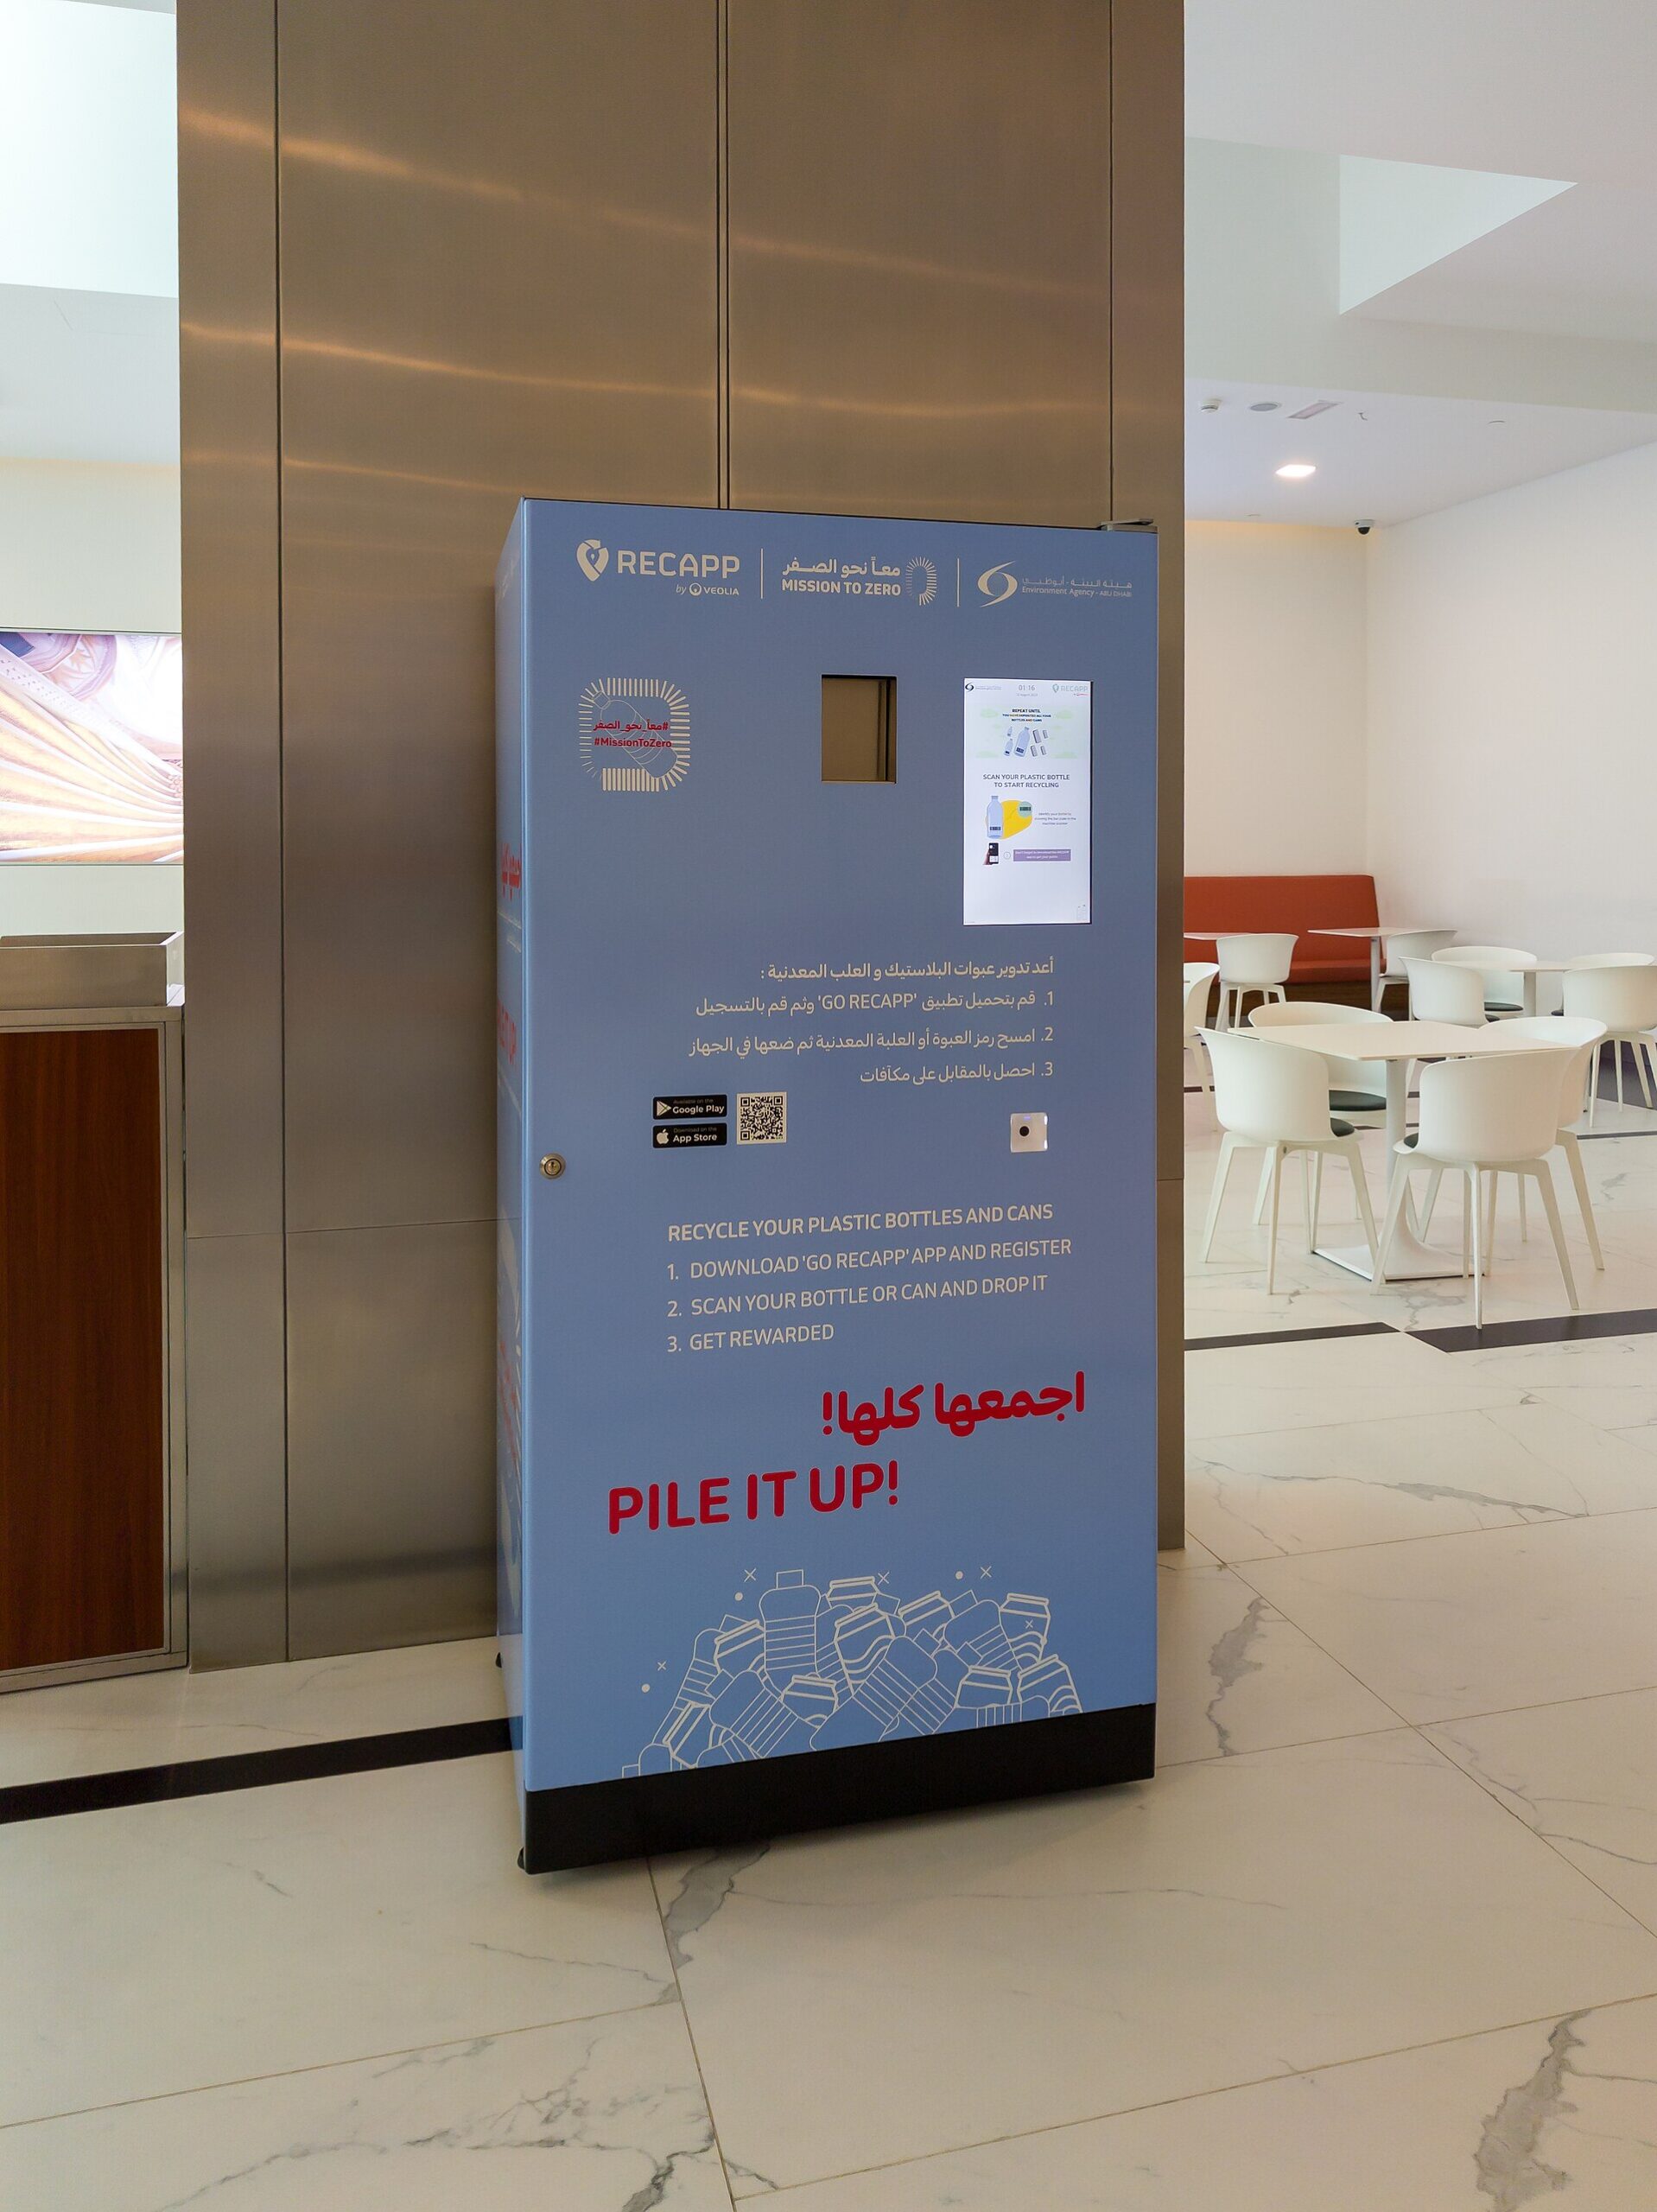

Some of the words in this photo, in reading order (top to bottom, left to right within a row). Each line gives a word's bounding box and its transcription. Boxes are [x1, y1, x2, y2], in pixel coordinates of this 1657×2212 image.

[617, 550, 740, 579] RECAPP
[782, 556, 837, 575] الصفر
[841, 562, 867, 578] نحو
[676, 584, 686, 595] by
[703, 587, 740, 595] VEOLIA
[782, 579, 841, 594] MISSION
[843, 582, 862, 594] TO
[865, 582, 901, 596] ZERO
[1022, 586, 1067, 594] Environment
[1070, 588, 1095, 598] Agency
[594, 737, 672, 748] #MissionToZero
[768, 963, 827, 982] المعدنية
[829, 963, 871, 981] العلب
[885, 962, 951, 979] البلاستيك
[954, 961, 995, 979] عبوات
[996, 962, 1030, 979] تدوير
[1032, 956, 1054, 974] أعد
[696, 997, 765, 1015] بالتسجيل
[767, 996, 788, 1017] قم
[790, 996, 815, 1016] وثم
[922, 993, 963, 1011] تطبيق
[966, 992, 1015, 1009] بتحميل
[1017, 990, 1036, 1010] قم
[1044, 991, 1054, 1006] 1.
[816, 1032, 873, 1052] المعدنية
[876, 1033, 915, 1050] العلبة
[917, 1027, 930, 1050] أو
[933, 1030, 972, 1049] العبوة
[973, 1033, 994, 1048] رمز
[997, 1028, 1035, 1048] امسح
[1041, 1027, 1053, 1041] 2.
[689, 1037, 733, 1057] الجهاز
[737, 1036, 751, 1059] في
[754, 1036, 794, 1054] ضعها
[797, 1035, 813, 1055] ثم
[912, 1066, 936, 1085] على
[938, 1065, 992, 1083] بالمقابل
[994, 1062, 1035, 1080] احصل
[1041, 1062, 1053, 1077] 3.
[672, 1105, 704, 1115] Google
[706, 1104, 725, 1114] Play
[672, 1135, 692, 1144] App
[694, 1133, 718, 1141] Store
[668, 1221, 749, 1242] RECYCLE
[752, 1217, 803, 1237] YOUR
[808, 1213, 881, 1233] PLASTIC
[885, 1209, 962, 1229] BOTTLES
[966, 1207, 1004, 1224] AND
[1007, 1204, 1053, 1221] CANS
[667, 1263, 679, 1281] 1.
[691, 1255, 799, 1279] DOWNLOAD
[911, 1246, 947, 1264] APP
[949, 1244, 987, 1262] AND
[990, 1239, 1071, 1259] REGISTER
[667, 1300, 682, 1318] 2.
[691, 1295, 741, 1315] SCAN
[745, 1292, 796, 1312] YOUR
[801, 1287, 868, 1307] BOTTLE
[873, 1285, 897, 1302] OR
[901, 1282, 936, 1300] CAN
[940, 1279, 978, 1297] AND
[982, 1276, 1029, 1294] DROP
[1032, 1274, 1048, 1291] IT
[667, 1336, 682, 1353] 3.
[689, 1332, 727, 1351] GET
[730, 1324, 835, 1348] REWARDED
[934, 1370, 1085, 1438] اجمعها
[822, 1384, 925, 1446] كلها!
[609, 1477, 730, 1535] PILE
[746, 1471, 797, 1521] IT
[809, 1459, 899, 1513] UP!
